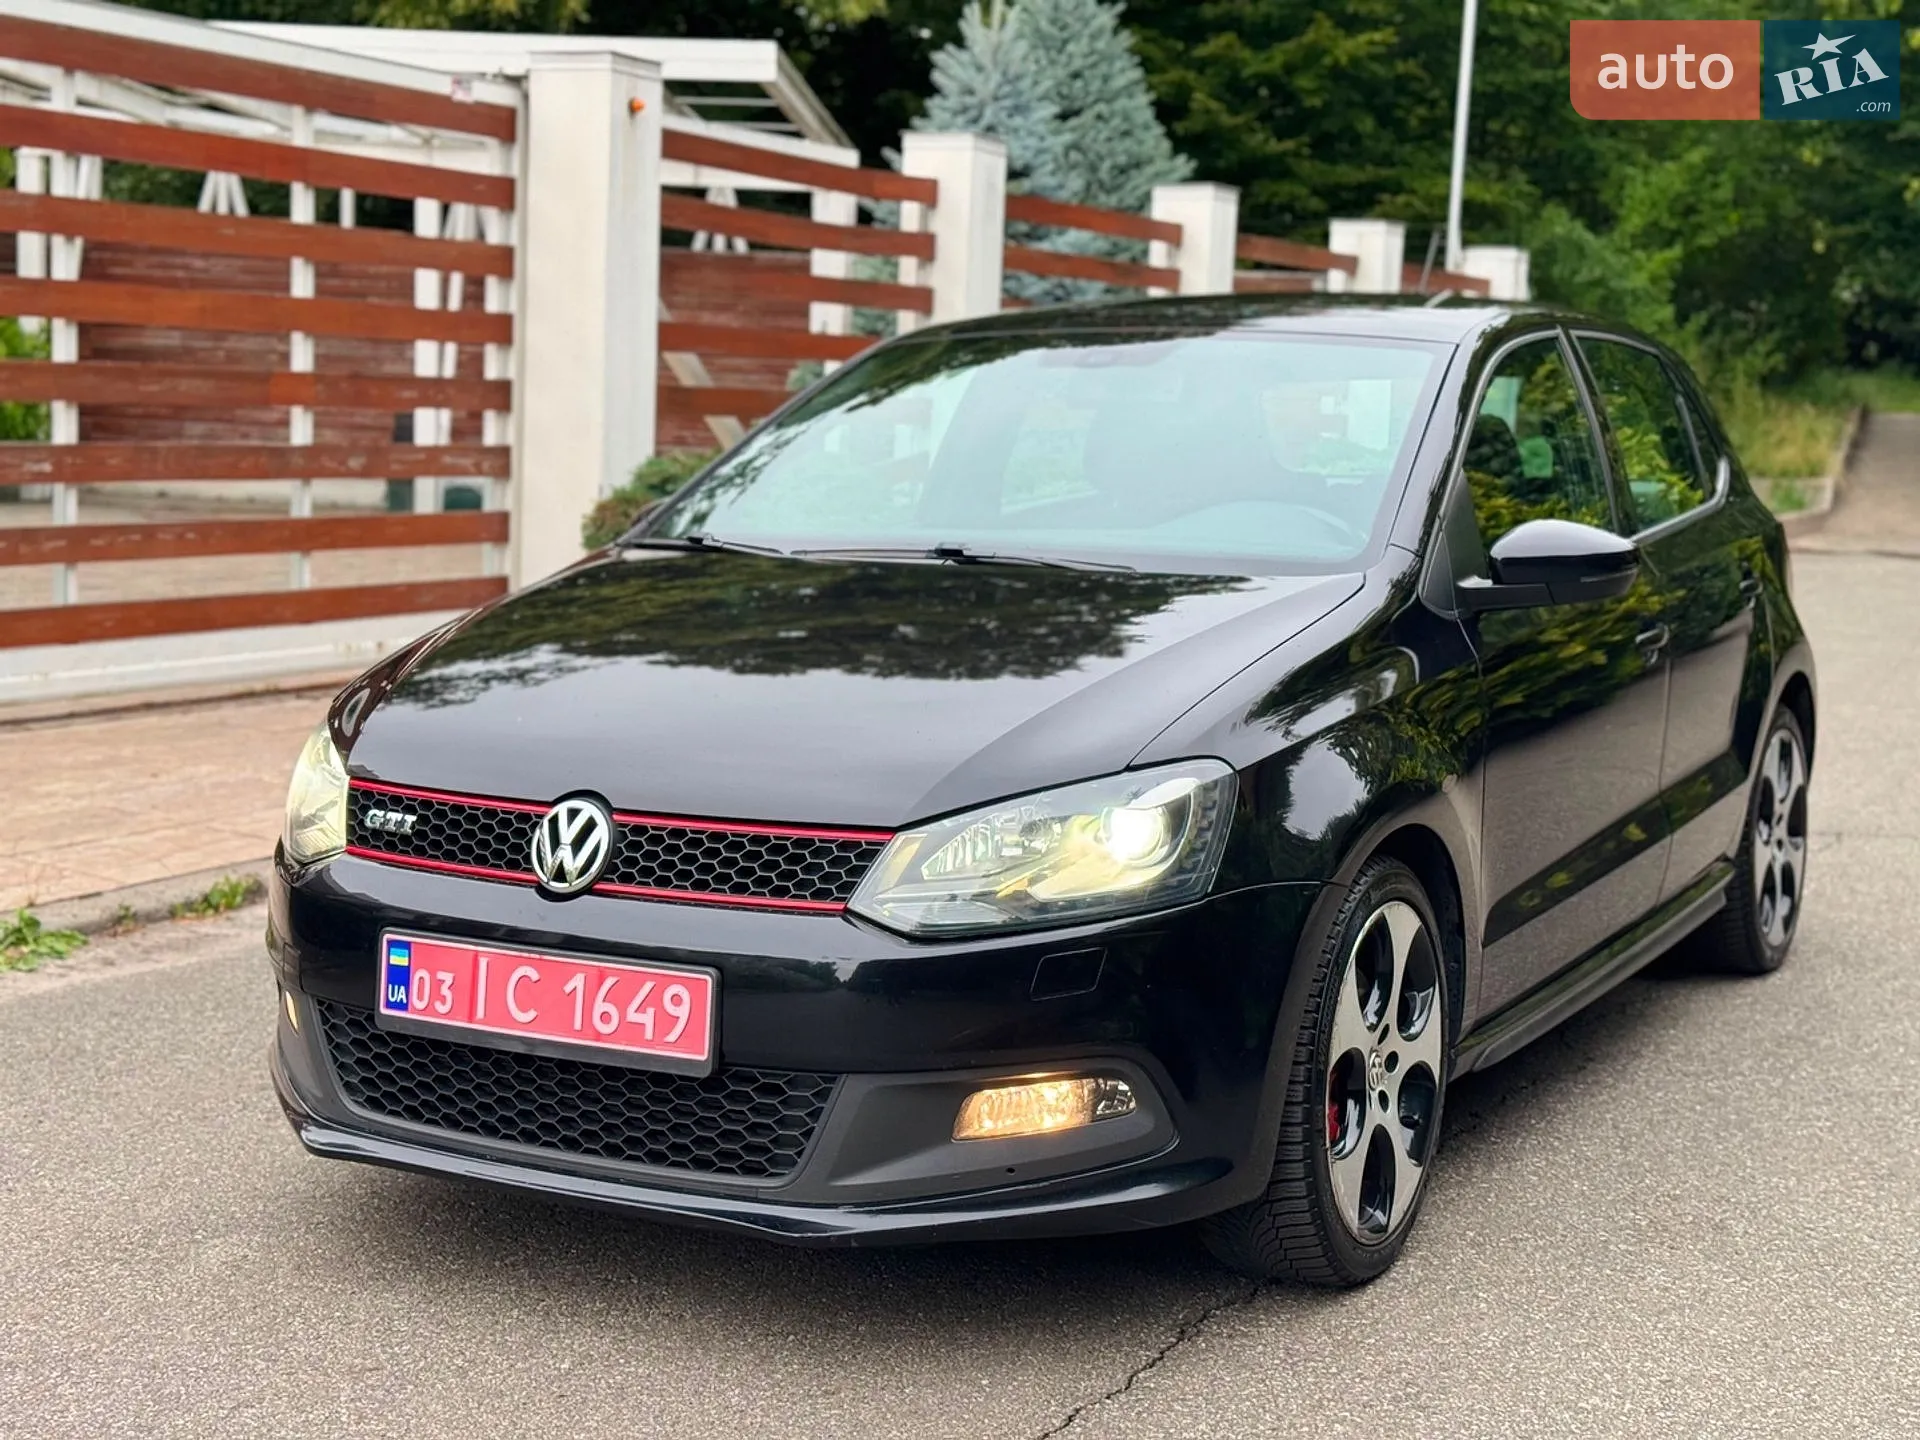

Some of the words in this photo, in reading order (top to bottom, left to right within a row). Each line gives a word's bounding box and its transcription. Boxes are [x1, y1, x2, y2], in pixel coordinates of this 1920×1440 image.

[363, 808, 418, 835] GTI
[388, 984, 407, 1004] UA
[411, 968, 455, 1015] 03
[562, 972, 692, 1043] 1649
